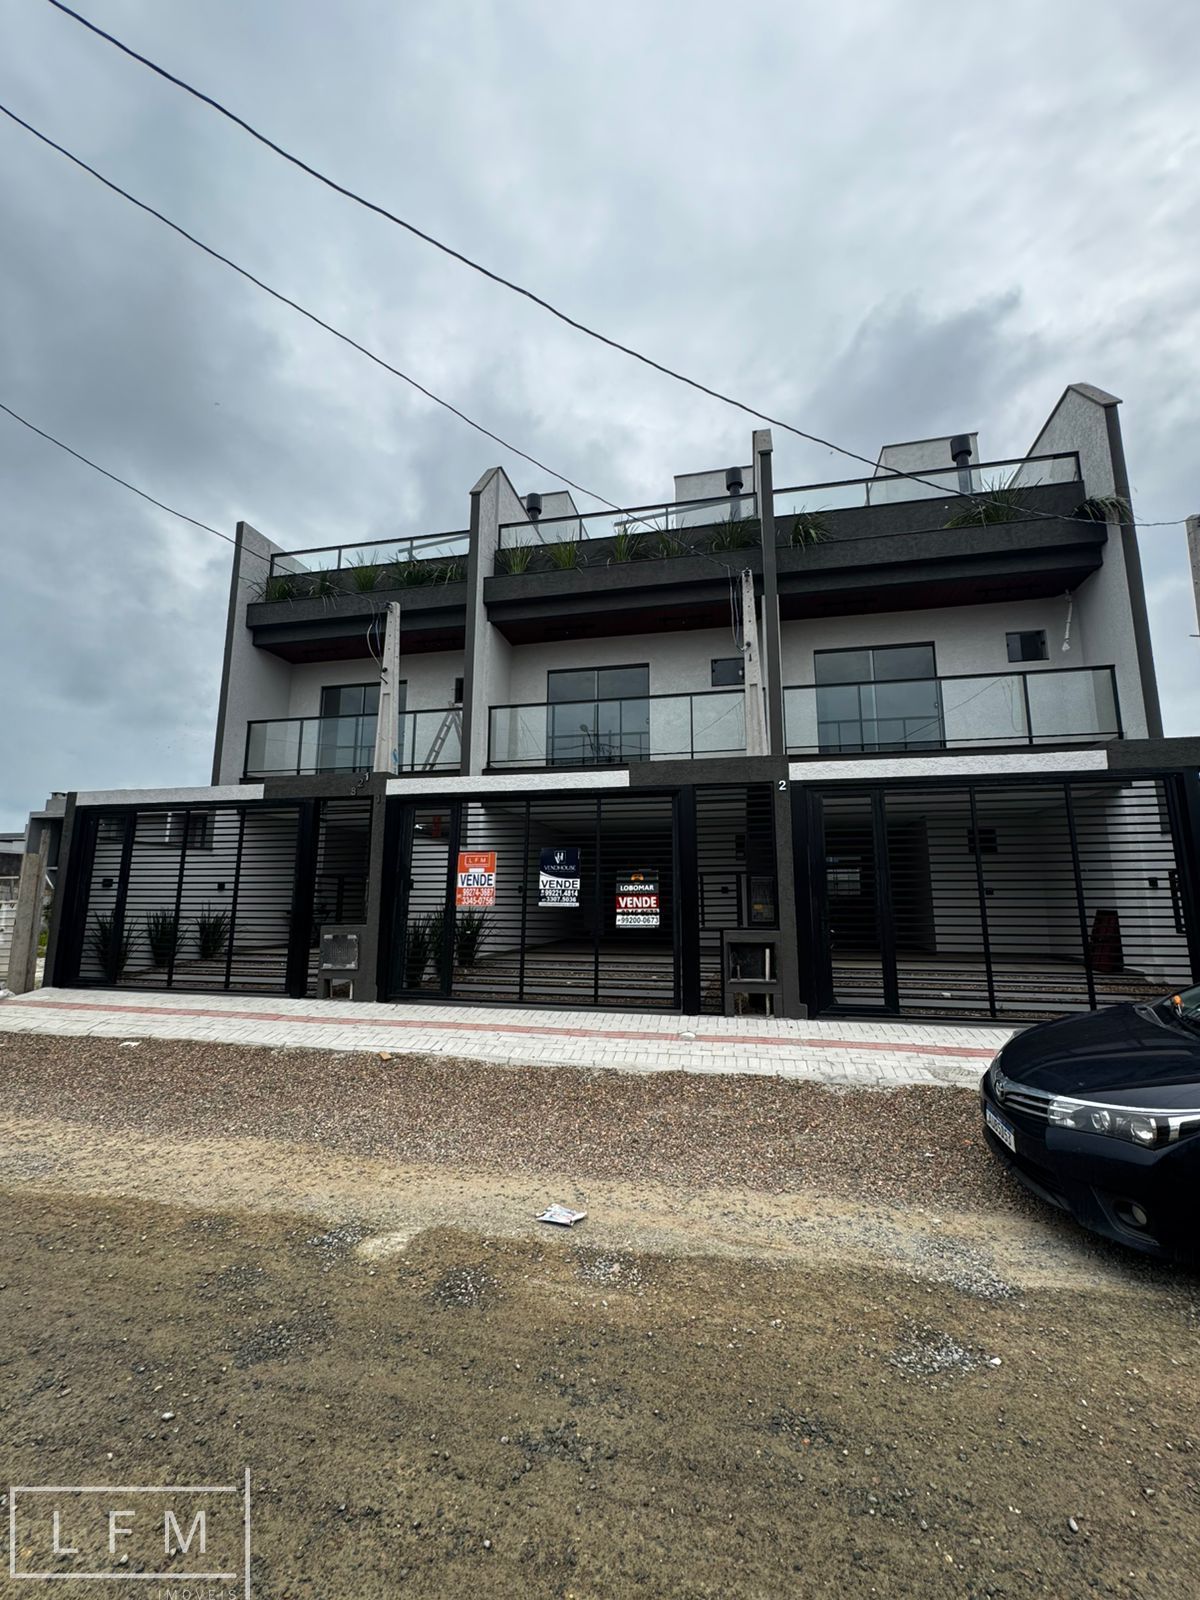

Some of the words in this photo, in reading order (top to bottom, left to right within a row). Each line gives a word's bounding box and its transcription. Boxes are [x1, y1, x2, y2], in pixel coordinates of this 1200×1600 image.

[778, 780, 786, 790] 2
[460, 874, 493, 886] VENDE
[541, 880, 579, 888] VENDE
[618, 896, 657, 907] VENDE
